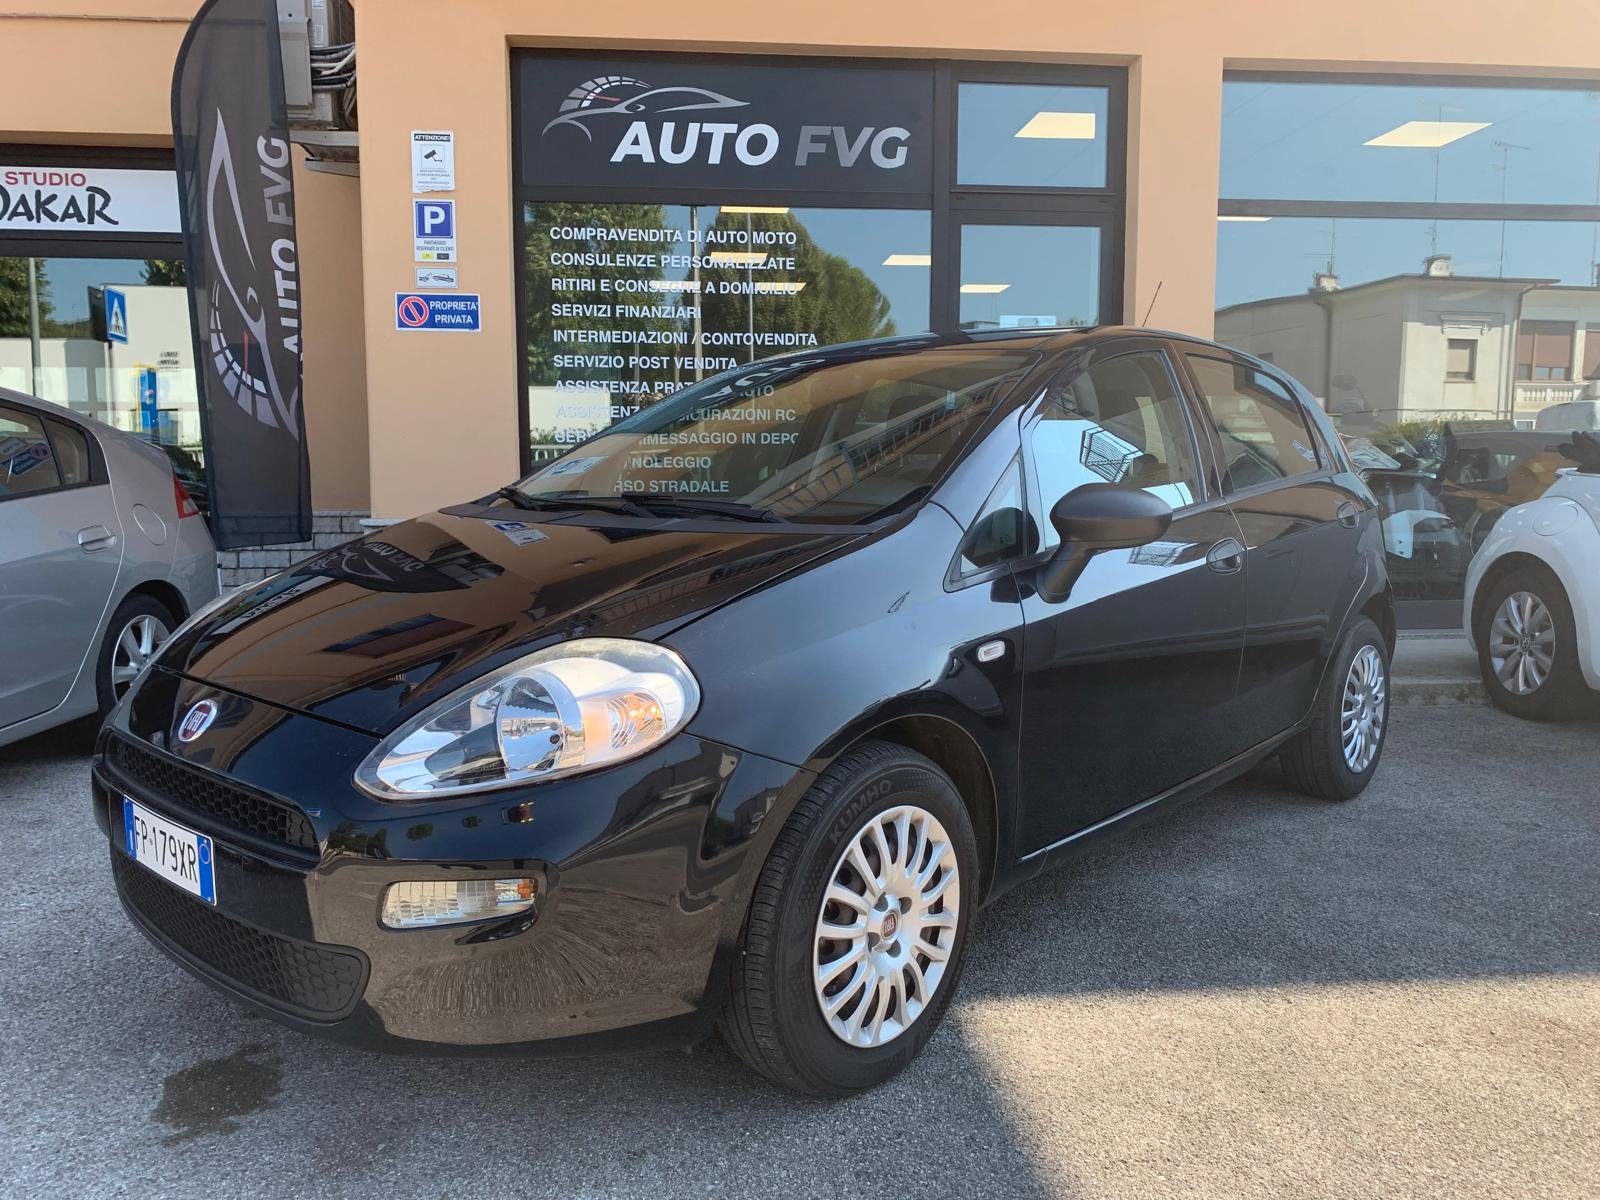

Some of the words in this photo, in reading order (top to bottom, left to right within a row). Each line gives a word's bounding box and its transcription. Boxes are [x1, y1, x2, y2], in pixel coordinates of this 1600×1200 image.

[609, 121, 780, 166] AUTO
[795, 126, 911, 169] FVG
[5, 171, 87, 187] STUDIO
[256, 135, 294, 226] FVG
[424, 205, 446, 234] P
[550, 227, 683, 242] COMPRAVENDITA
[688, 230, 701, 243] DI
[706, 230, 748, 244] AUTO
[752, 231, 797, 245] MOTO
[550, 252, 657, 267] CONSULENZE
[661, 255, 796, 270] PERSONALIZZATE
[551, 278, 596, 292] RITIRI
[600, 279, 611, 292] E
[614, 280, 701, 293] CONSEGNE
[705, 282, 716, 294] A
[719, 282, 798, 295] DOMICILIO
[434, 314, 474, 324] PRIVATA
[551, 304, 611, 318] SERVIZI
[615, 305, 701, 319] FINANZIARI
[553, 330, 688, 345] INTERMEDIAZIONI
[700, 332, 818, 346] CONTOVENDITA
[553, 355, 625, 369] SERVIZIO
[628, 356, 670, 369] POST
[673, 357, 738, 371] VENDITA
[555, 379, 651, 394] ASSISTENZA
[741, 432, 756, 445] IN
[632, 456, 712, 469] NOLEGGIO
[648, 479, 729, 493] STRADALE
[828, 778, 893, 846] KUMHO
